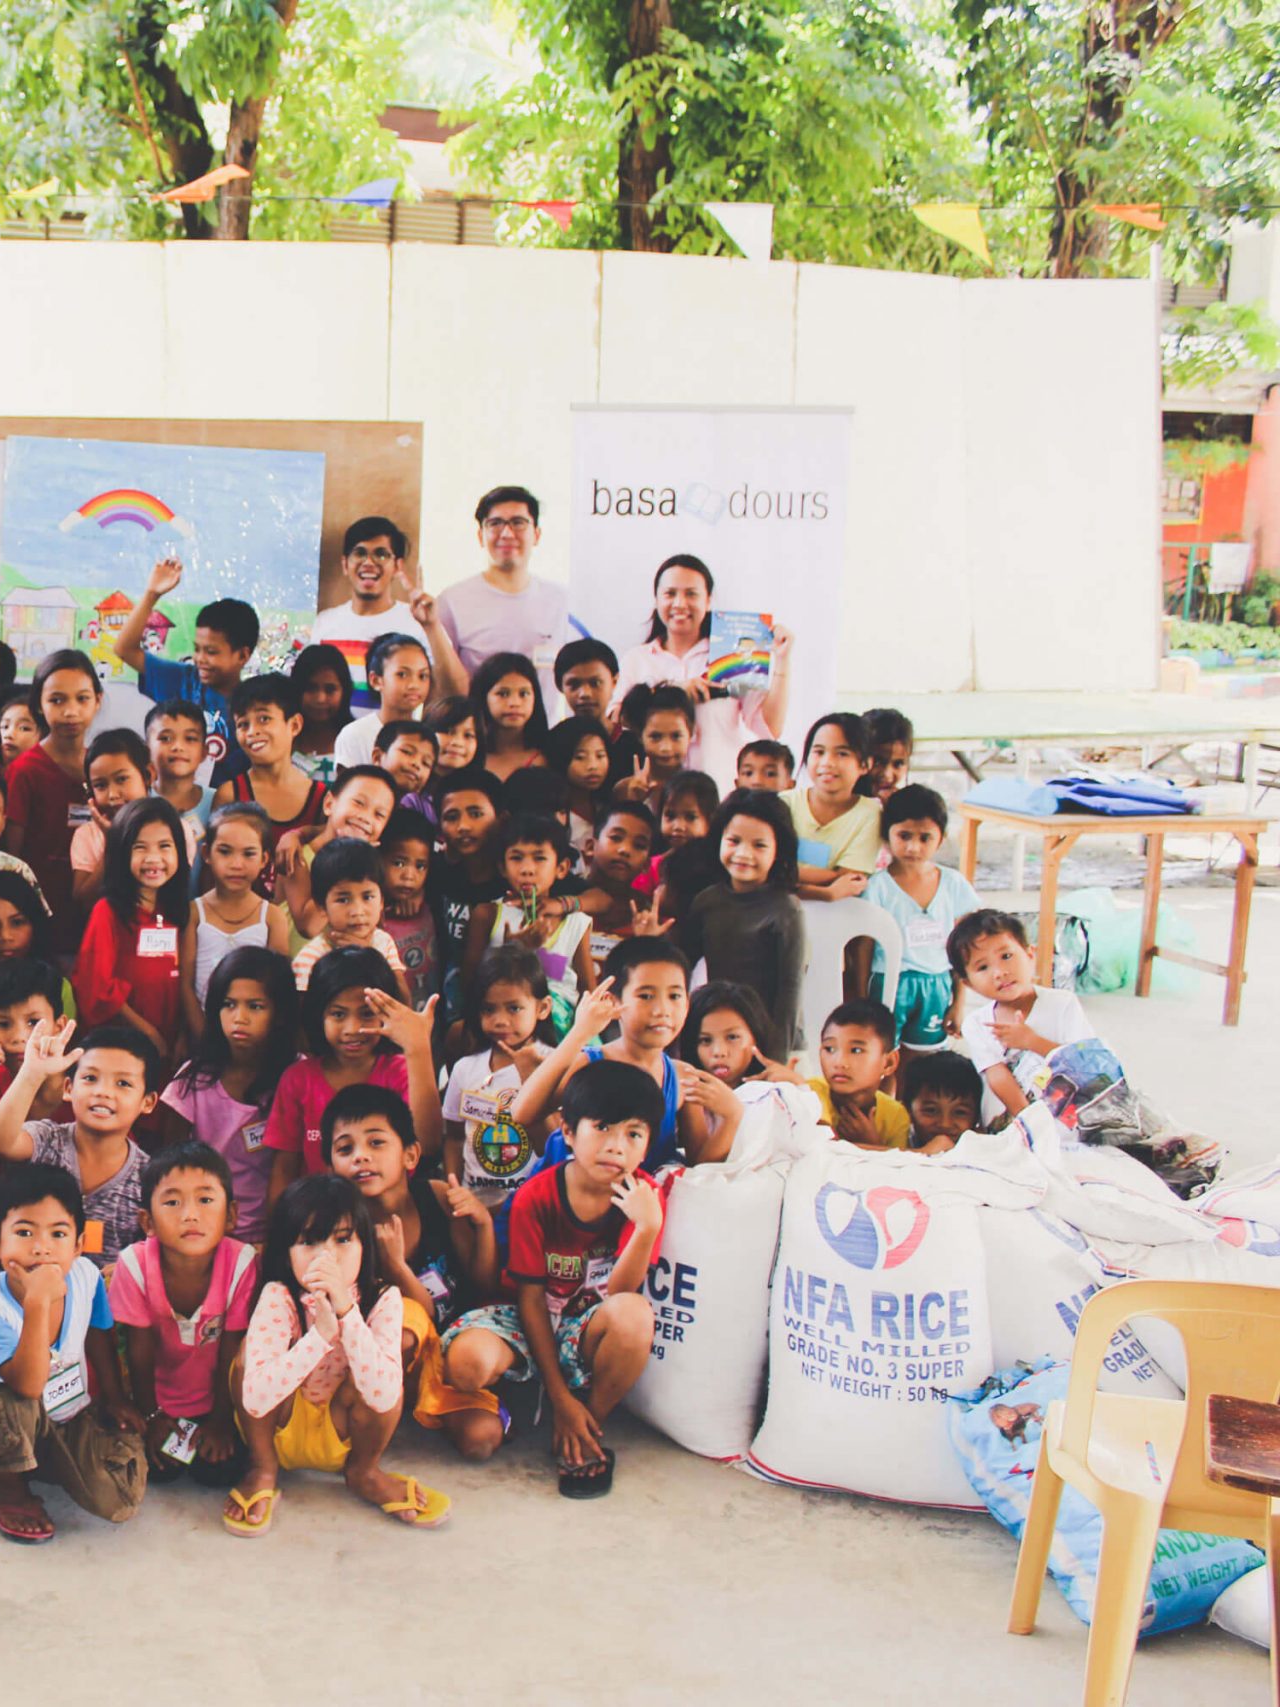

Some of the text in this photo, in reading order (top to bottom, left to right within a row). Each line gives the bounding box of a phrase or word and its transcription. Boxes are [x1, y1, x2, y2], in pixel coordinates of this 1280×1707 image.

[591, 480, 828, 520] basa dours
[306, 1129, 322, 1141] CEP
[637, 1256, 698, 1309] CE
[784, 1265, 970, 1340] NFA RICE
[654, 1321, 684, 1343] PER
[784, 1315, 970, 1358] WELL MILLED
[787, 1334, 964, 1381] GRADE NO. 3 SUPER
[1103, 1338, 1149, 1373] GRAD
[801, 1361, 825, 1383] NET
[829, 1371, 892, 1401] WEIGHT
[907, 1386, 926, 1402] 50
[1152, 1575, 1182, 1599] NET
[1184, 1557, 1238, 1590] WEIGHT
